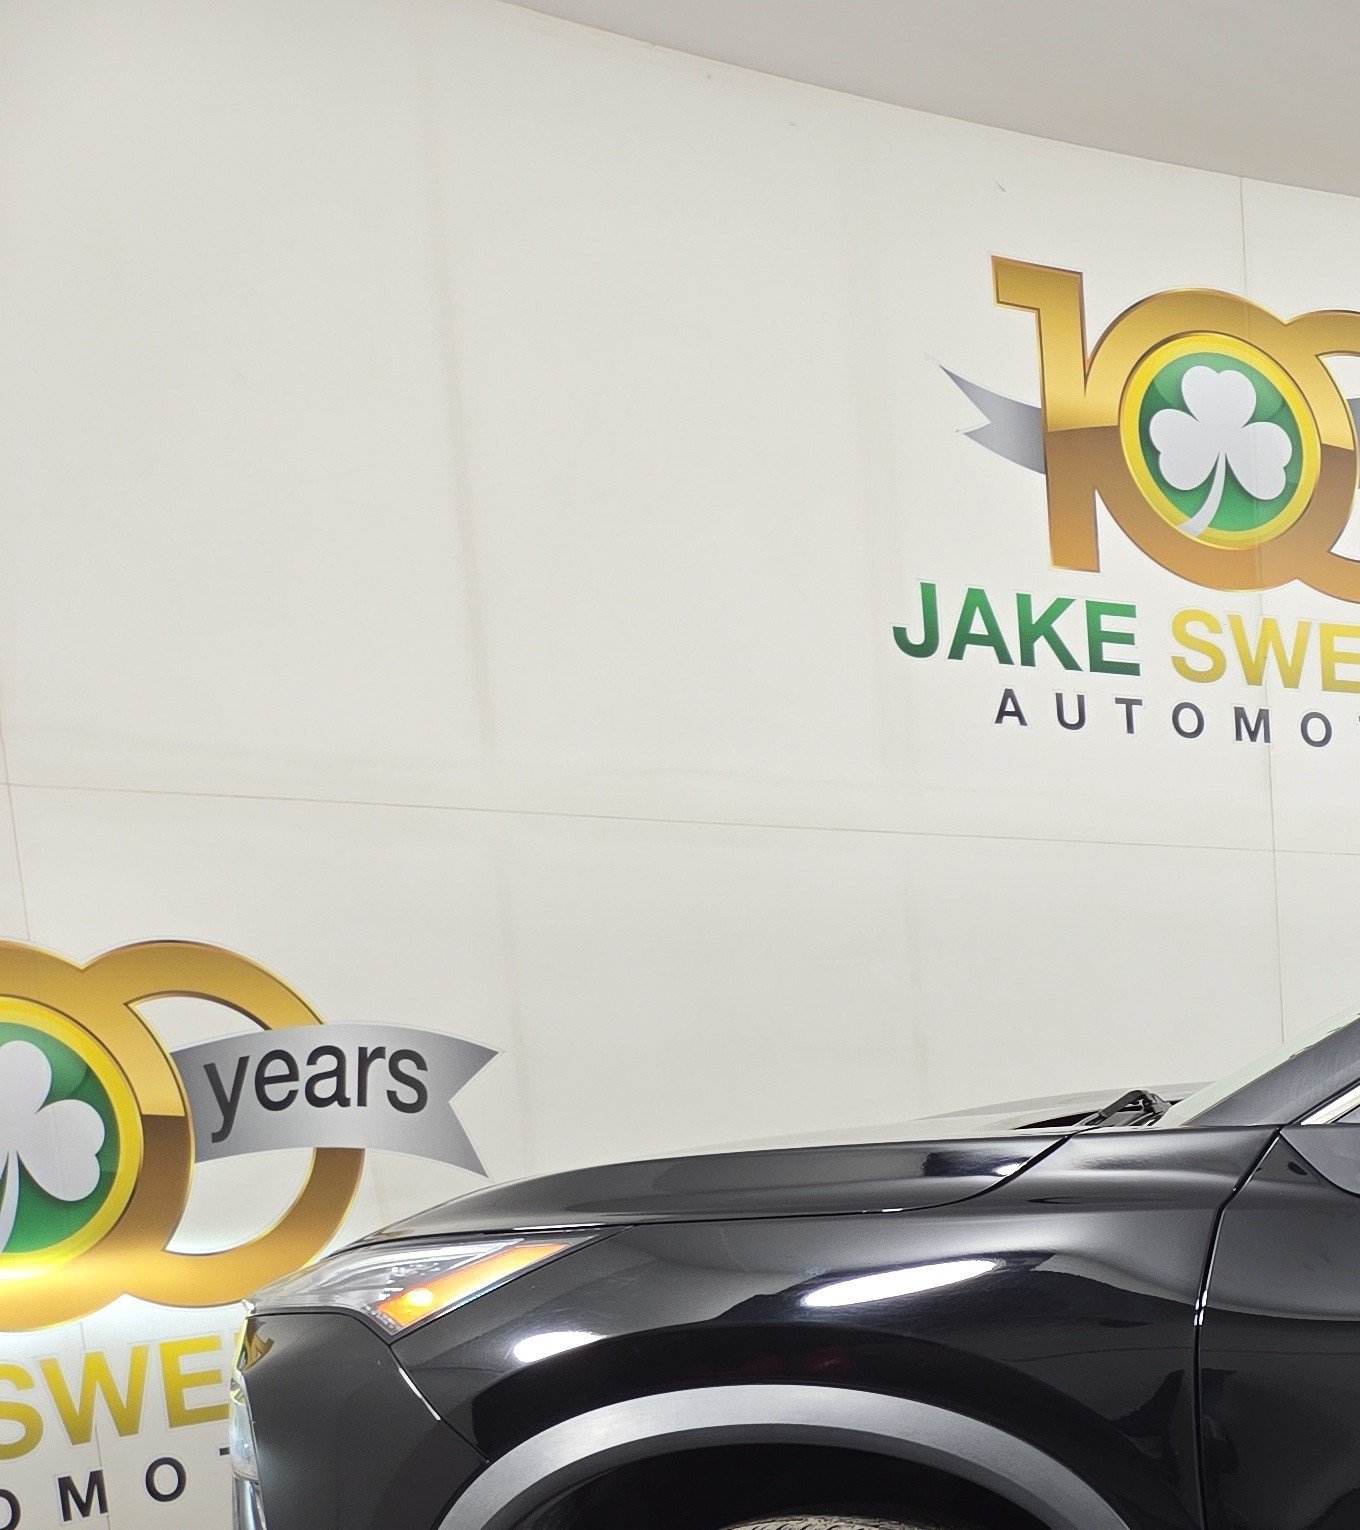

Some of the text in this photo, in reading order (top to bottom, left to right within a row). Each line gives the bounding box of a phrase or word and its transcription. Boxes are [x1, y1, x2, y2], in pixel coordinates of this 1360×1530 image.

[892, 582, 1142, 676] JAKE
[204, 1044, 429, 1143] years
[0, 1335, 243, 1461] SWE
